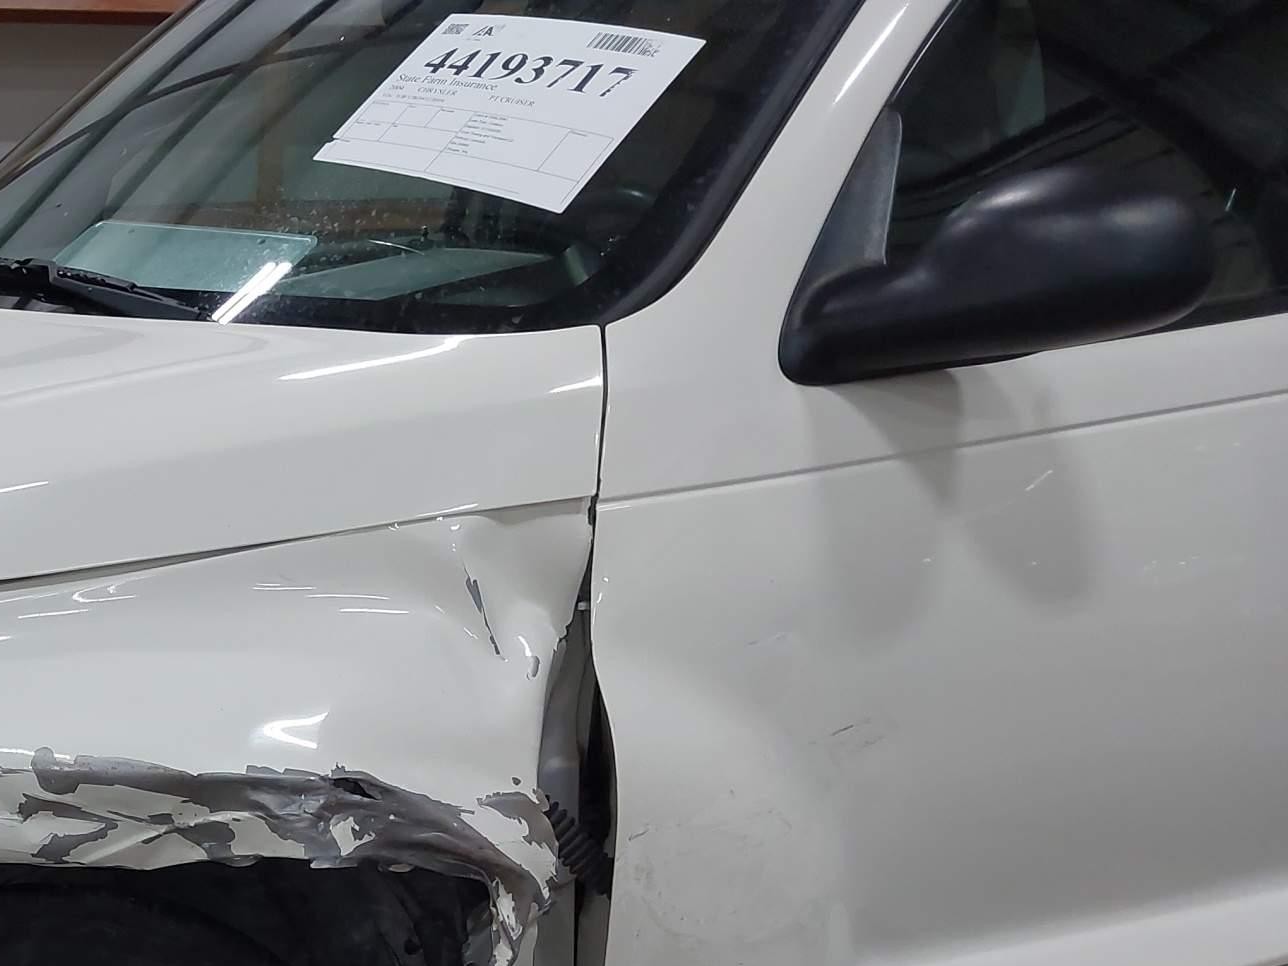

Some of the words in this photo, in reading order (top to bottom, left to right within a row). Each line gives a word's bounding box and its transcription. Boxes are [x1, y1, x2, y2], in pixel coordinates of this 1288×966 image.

[424, 48, 639, 97] 44193717
[396, 74, 418, 83] State
[420, 75, 448, 86] Farm
[449, 77, 498, 91] Insurance
[417, 86, 458, 96] CHRYSLER
